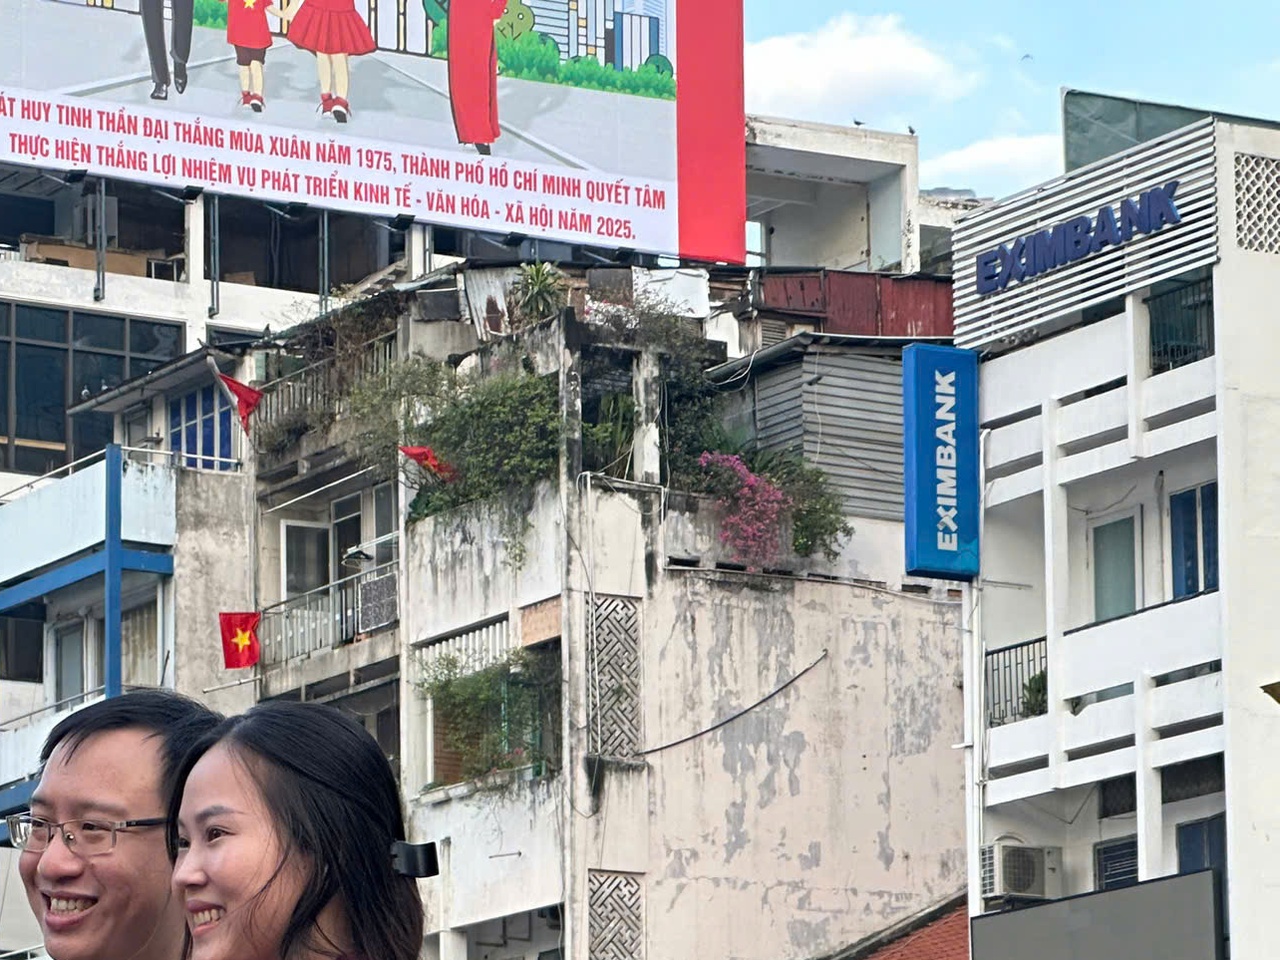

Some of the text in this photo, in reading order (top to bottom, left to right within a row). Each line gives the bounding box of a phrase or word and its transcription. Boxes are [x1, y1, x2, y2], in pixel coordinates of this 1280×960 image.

[9, 133, 50, 161] THỰC
[55, 137, 91, 166] HIỆN
[96, 140, 148, 172] THẮNG
[153, 152, 176, 179] LỢI
[182, 157, 232, 186] NHIỆM
[237, 165, 256, 193] VỤ
[261, 168, 300, 193] PHÁT
[305, 170, 349, 200] TRIỂN
[354, 181, 390, 205] KINH
[395, 181, 412, 208] TẾ
[426, 188, 456, 215] VĂN
[461, 194, 490, 219] HÓA
[505, 200, 524, 224] XÃ
[529, 203, 553, 231] HỘI
[558, 208, 592, 233] NĂM
[596, 216, 636, 240] 2025.
[21, 99, 51, 122] HUY
[56, 104, 92, 129] TINH
[97, 106, 138, 136] THẦN
[143, 116, 169, 143] ĐẠI
[173, 117, 224, 149] THẮNG
[229, 127, 264, 154] MÙA
[269, 134, 311, 161] XUÂN
[316, 138, 351, 166] NĂM
[356, 148, 397, 174] 1975,
[401, 151, 450, 181] THÀNH
[455, 157, 484, 185] PHỐ
[489, 161, 508, 188] HỒ
[513, 168, 537, 192] CHÍ
[542, 174, 581, 199] MINH
[586, 178, 630, 205] QUYẾT
[635, 184, 666, 210] TÂM
[976, 180, 1182, 295] EXIMBANK
[935, 369, 958, 551] EXIMBANK
